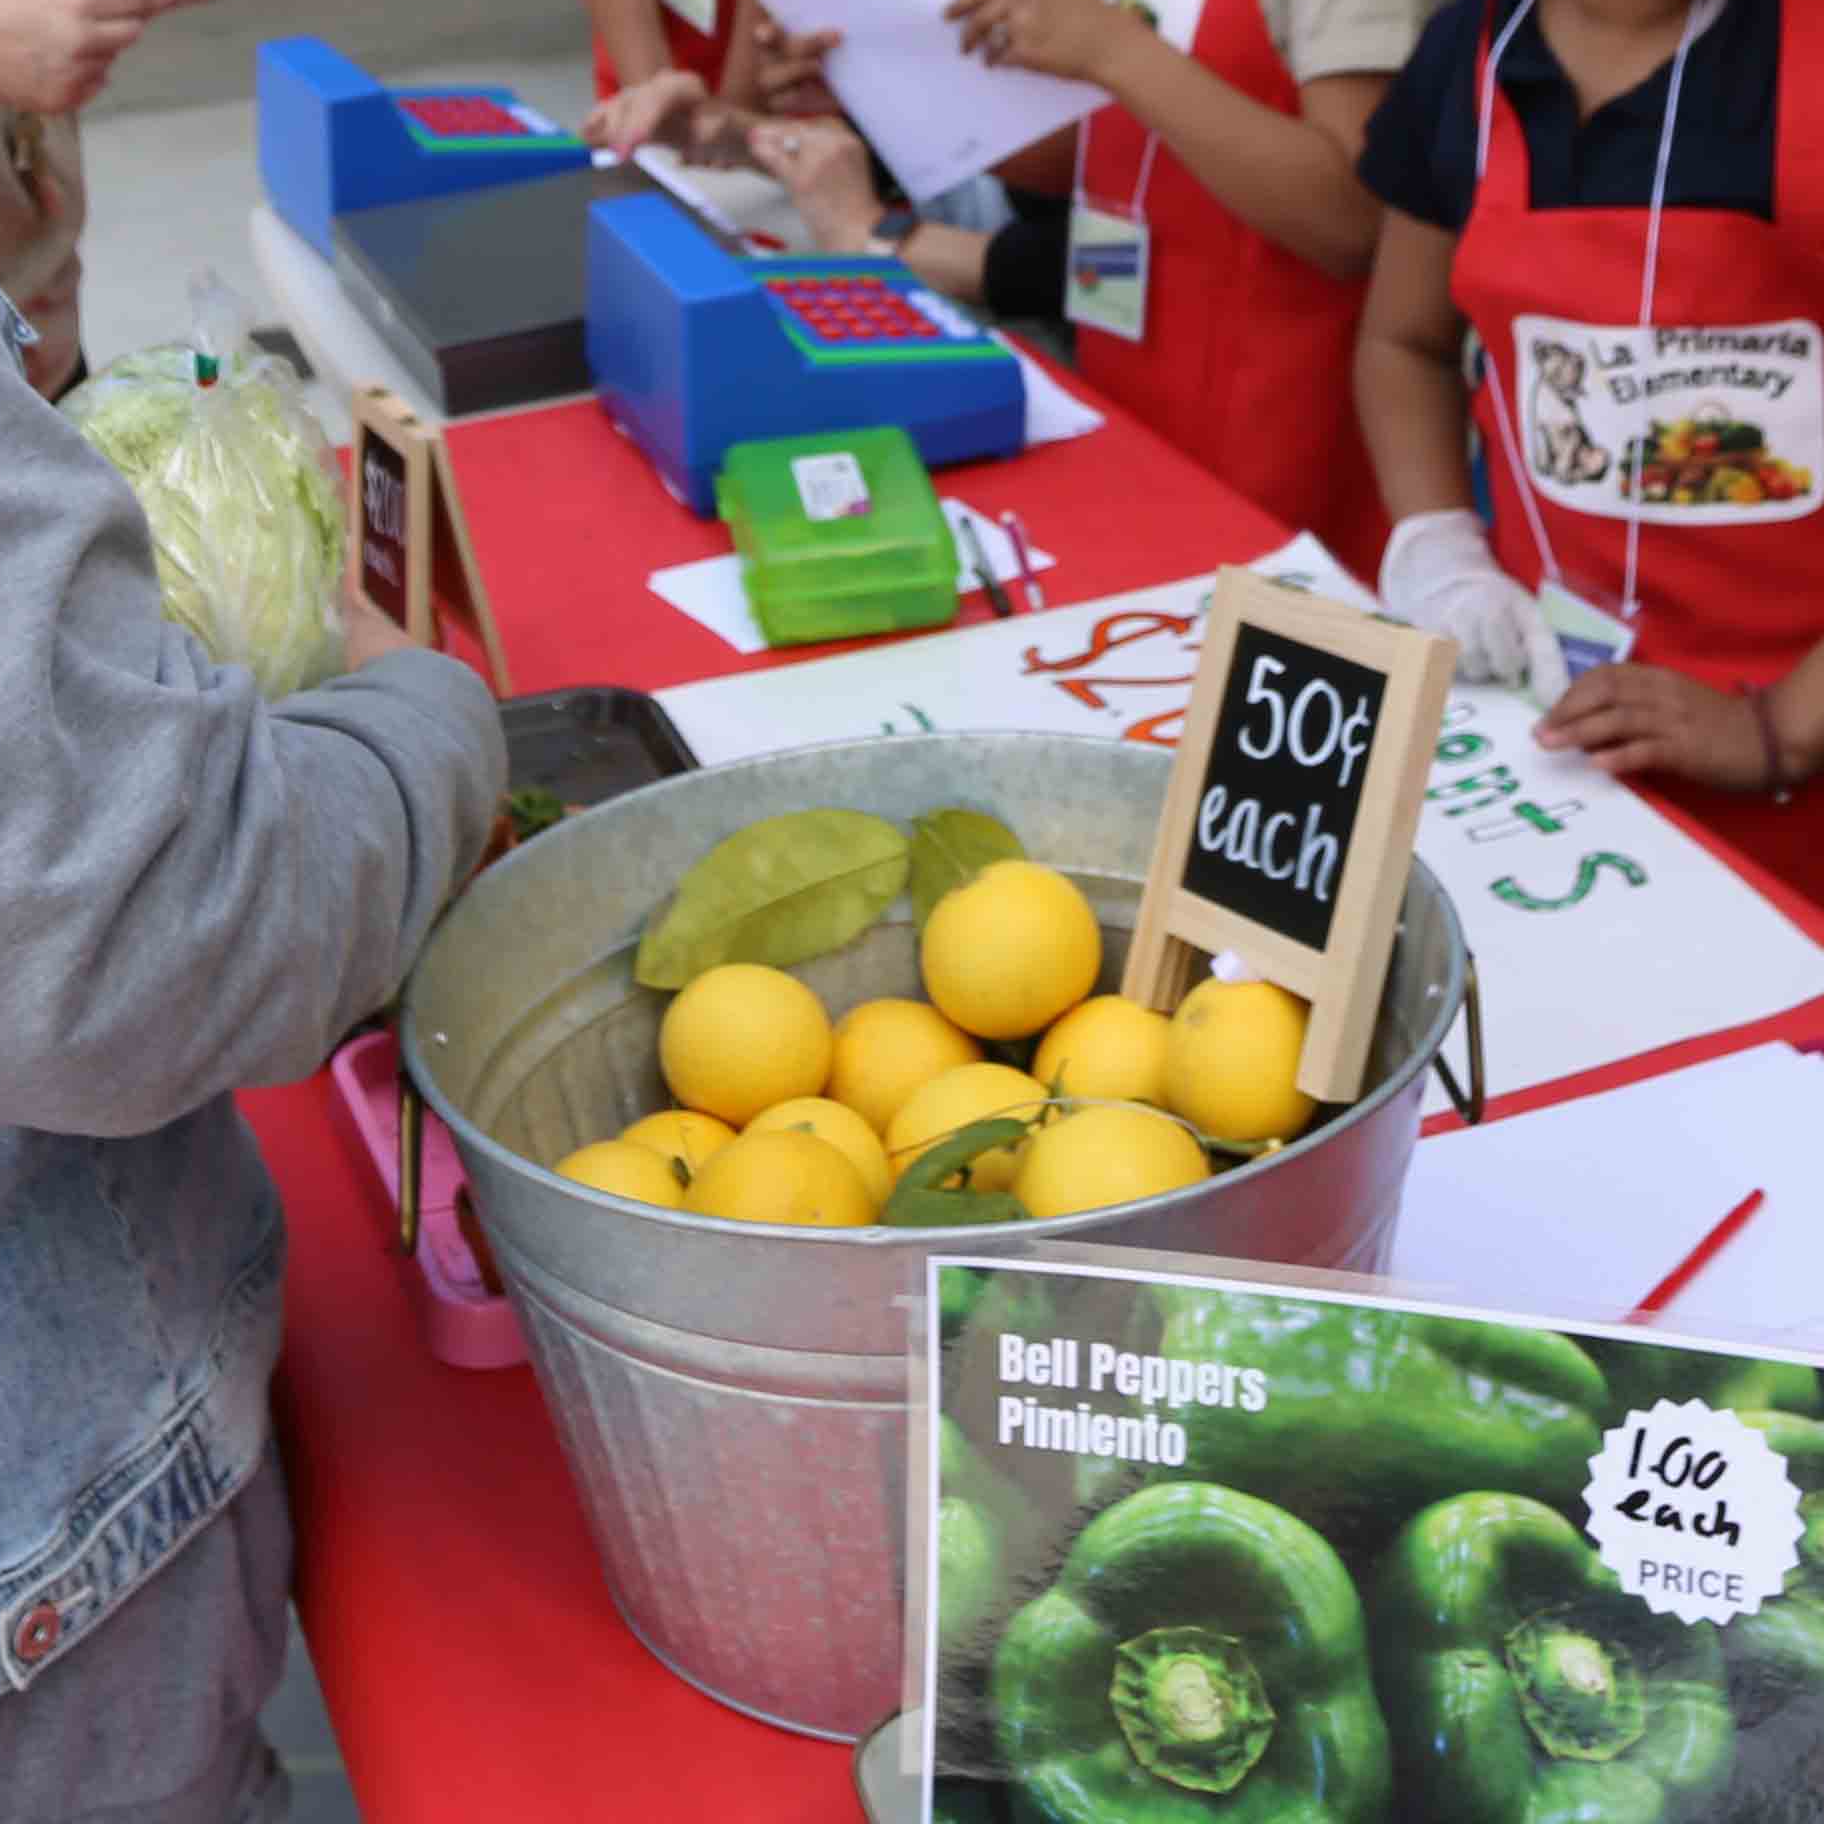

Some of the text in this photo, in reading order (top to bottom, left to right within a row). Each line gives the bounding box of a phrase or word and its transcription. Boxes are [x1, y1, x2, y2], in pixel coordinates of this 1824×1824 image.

[1587, 326, 1810, 369] La Primaria
[1606, 362, 1794, 404] Elementary
[1238, 655, 1372, 788] 50¢
[1198, 784, 1340, 903] each
[998, 1333, 1268, 1413] Bell Peppers
[998, 1395, 1188, 1467] Pimiento
[1613, 1489, 1741, 1547] each
[1639, 1560, 1745, 1603] PRICE
